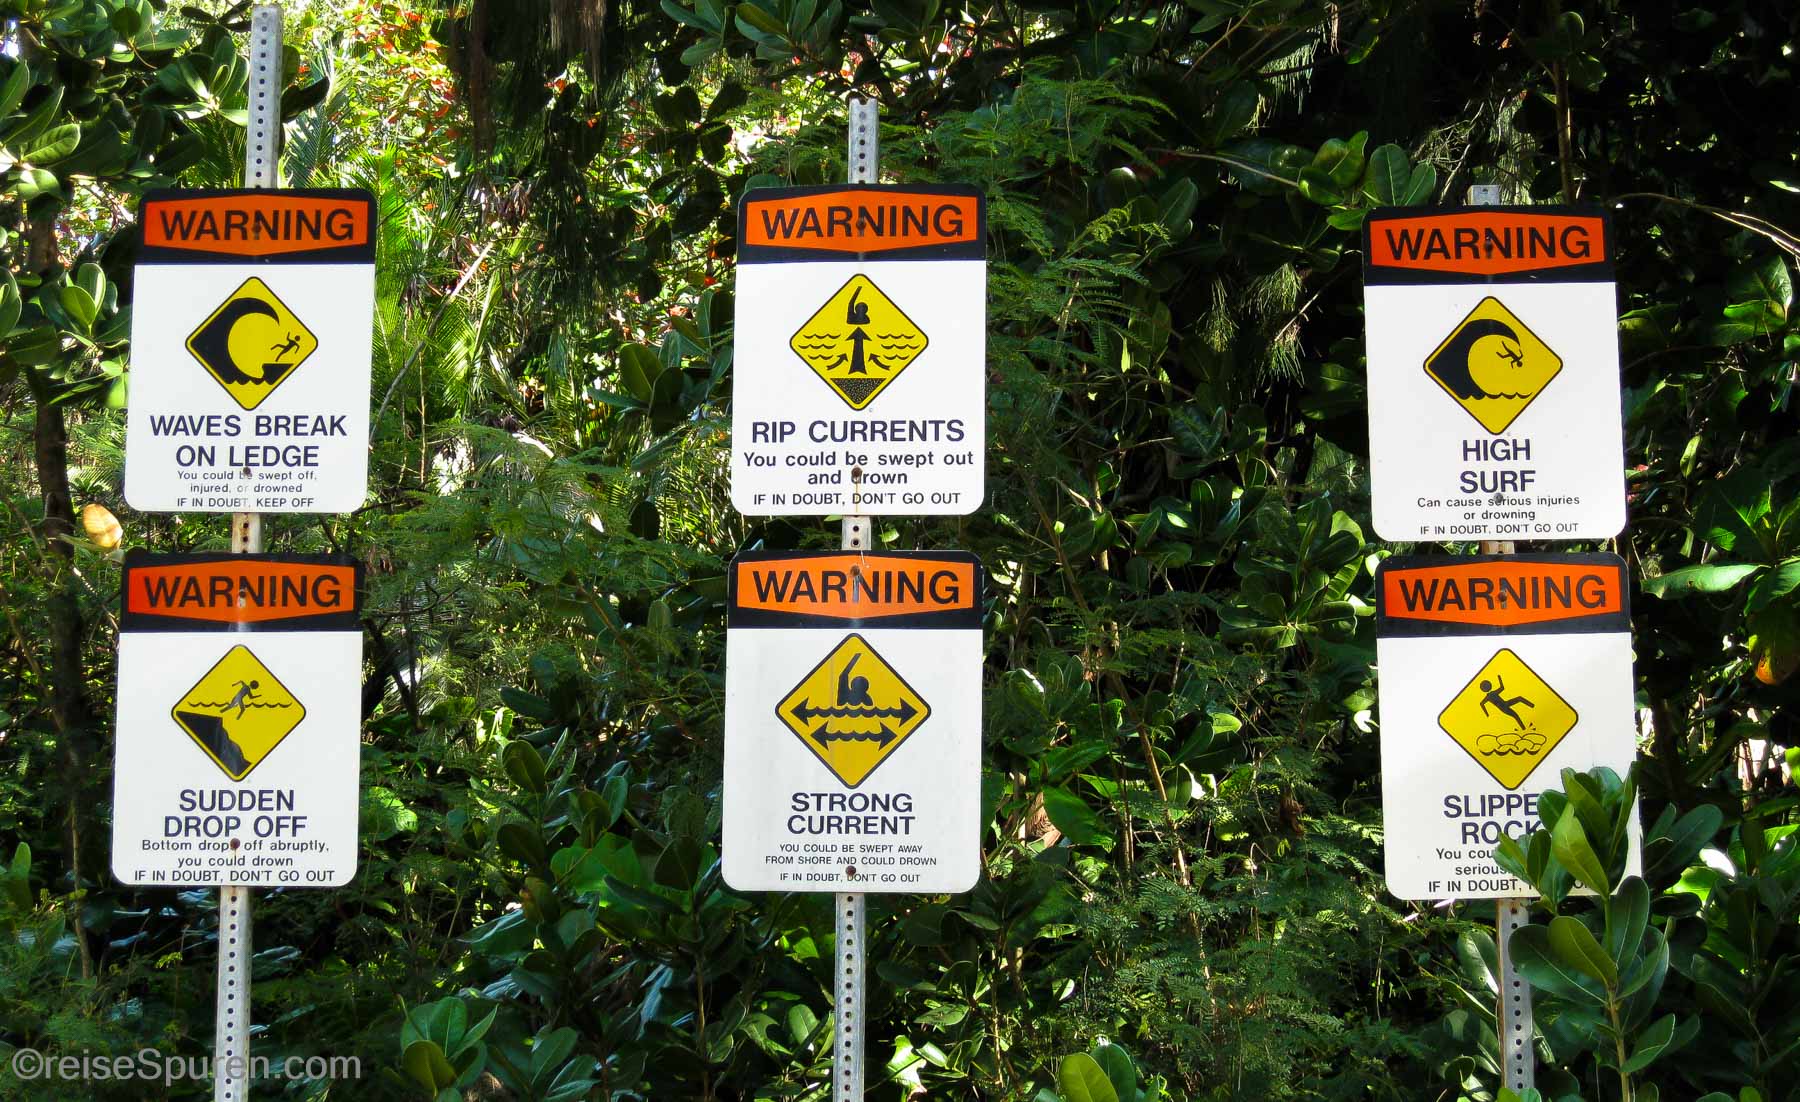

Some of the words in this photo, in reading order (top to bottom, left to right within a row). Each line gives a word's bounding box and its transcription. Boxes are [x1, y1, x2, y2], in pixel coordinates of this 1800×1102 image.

[160, 208, 354, 241] WARNING
[761, 204, 963, 239] WARNING
[1385, 225, 1590, 260] WARNING
[150, 415, 241, 437] WAVES
[255, 415, 347, 436] BREAK
[752, 421, 796, 443] RIP
[808, 420, 964, 442] CURRENTS
[176, 445, 215, 467] ON
[229, 445, 319, 467] LEDGE
[1463, 438, 1531, 462] HIGH
[744, 452, 776, 466] You
[786, 451, 836, 466] could
[846, 451, 868, 466] be
[878, 451, 934, 468] swept
[944, 451, 974, 465] out
[177, 471, 197, 480] You
[202, 471, 234, 480] could
[258, 471, 292, 481] swept
[808, 470, 841, 484] and
[1460, 470, 1536, 494] SURF
[254, 484, 302, 493] drowned
[177, 498, 187, 508] IF
[192, 498, 203, 508] IN
[256, 498, 286, 508] KEEP
[292, 498, 314, 508] OFF
[754, 494, 766, 504] IF
[772, 494, 786, 504] IN
[792, 493, 845, 506] DOUBT,
[852, 493, 896, 504] DON'T
[902, 493, 924, 504] GO
[930, 492, 960, 504] OUT
[1418, 498, 1440, 508] Can
[1446, 498, 1482, 506] cause
[1488, 496, 1532, 506] serious
[1537, 496, 1580, 507] injuries
[1464, 512, 1476, 520] or
[1482, 510, 1536, 520] drowning
[1420, 526, 1430, 535] IF
[1435, 526, 1445, 534] IN
[1496, 524, 1530, 534] DON'T
[1534, 524, 1550, 532] GO
[1556, 523, 1578, 532] OUT
[144, 575, 341, 608] WARNING
[752, 570, 960, 604] WARNING
[1400, 574, 1606, 611] WARNING
[180, 789, 294, 812] SUDDEN
[792, 792, 912, 812] STRONG
[1444, 794, 1540, 818] SLIPPE
[164, 816, 241, 838] DROP
[254, 816, 307, 838] OFF
[788, 815, 915, 835] CURRENT
[1462, 820, 1541, 844] ROCK
[142, 840, 192, 850] Bottom
[199, 840, 240, 852] drop
[244, 840, 264, 850] off
[270, 840, 329, 852] abruptly,
[780, 844, 800, 852] YOU
[804, 844, 838, 852] COULD
[842, 844, 854, 852] BE
[860, 844, 894, 853] SWEPT
[898, 844, 922, 853] AWAY
[1436, 848, 1461, 860] You
[1468, 850, 1493, 859] cou
[178, 858, 202, 868] you
[208, 856, 246, 866] could
[252, 856, 293, 866] drown
[766, 856, 794, 864] FROM
[798, 856, 832, 864] SHORE
[861, 857, 895, 865] COULD
[900, 857, 937, 866] DROWN
[134, 870, 146, 881] IF
[153, 870, 166, 881] IN
[172, 870, 224, 882] DOUBT,
[230, 870, 272, 882] DON'T
[278, 870, 300, 882] GO
[306, 870, 335, 882] OUT
[792, 874, 802, 882] IN
[806, 874, 842, 882] DOUBT,
[848, 874, 876, 882] DON'T
[881, 874, 896, 882] GO
[900, 874, 920, 882] OUT
[1428, 881, 1440, 892] IF
[1448, 880, 1461, 892] IN
[1468, 878, 1522, 892] DOUBT,
